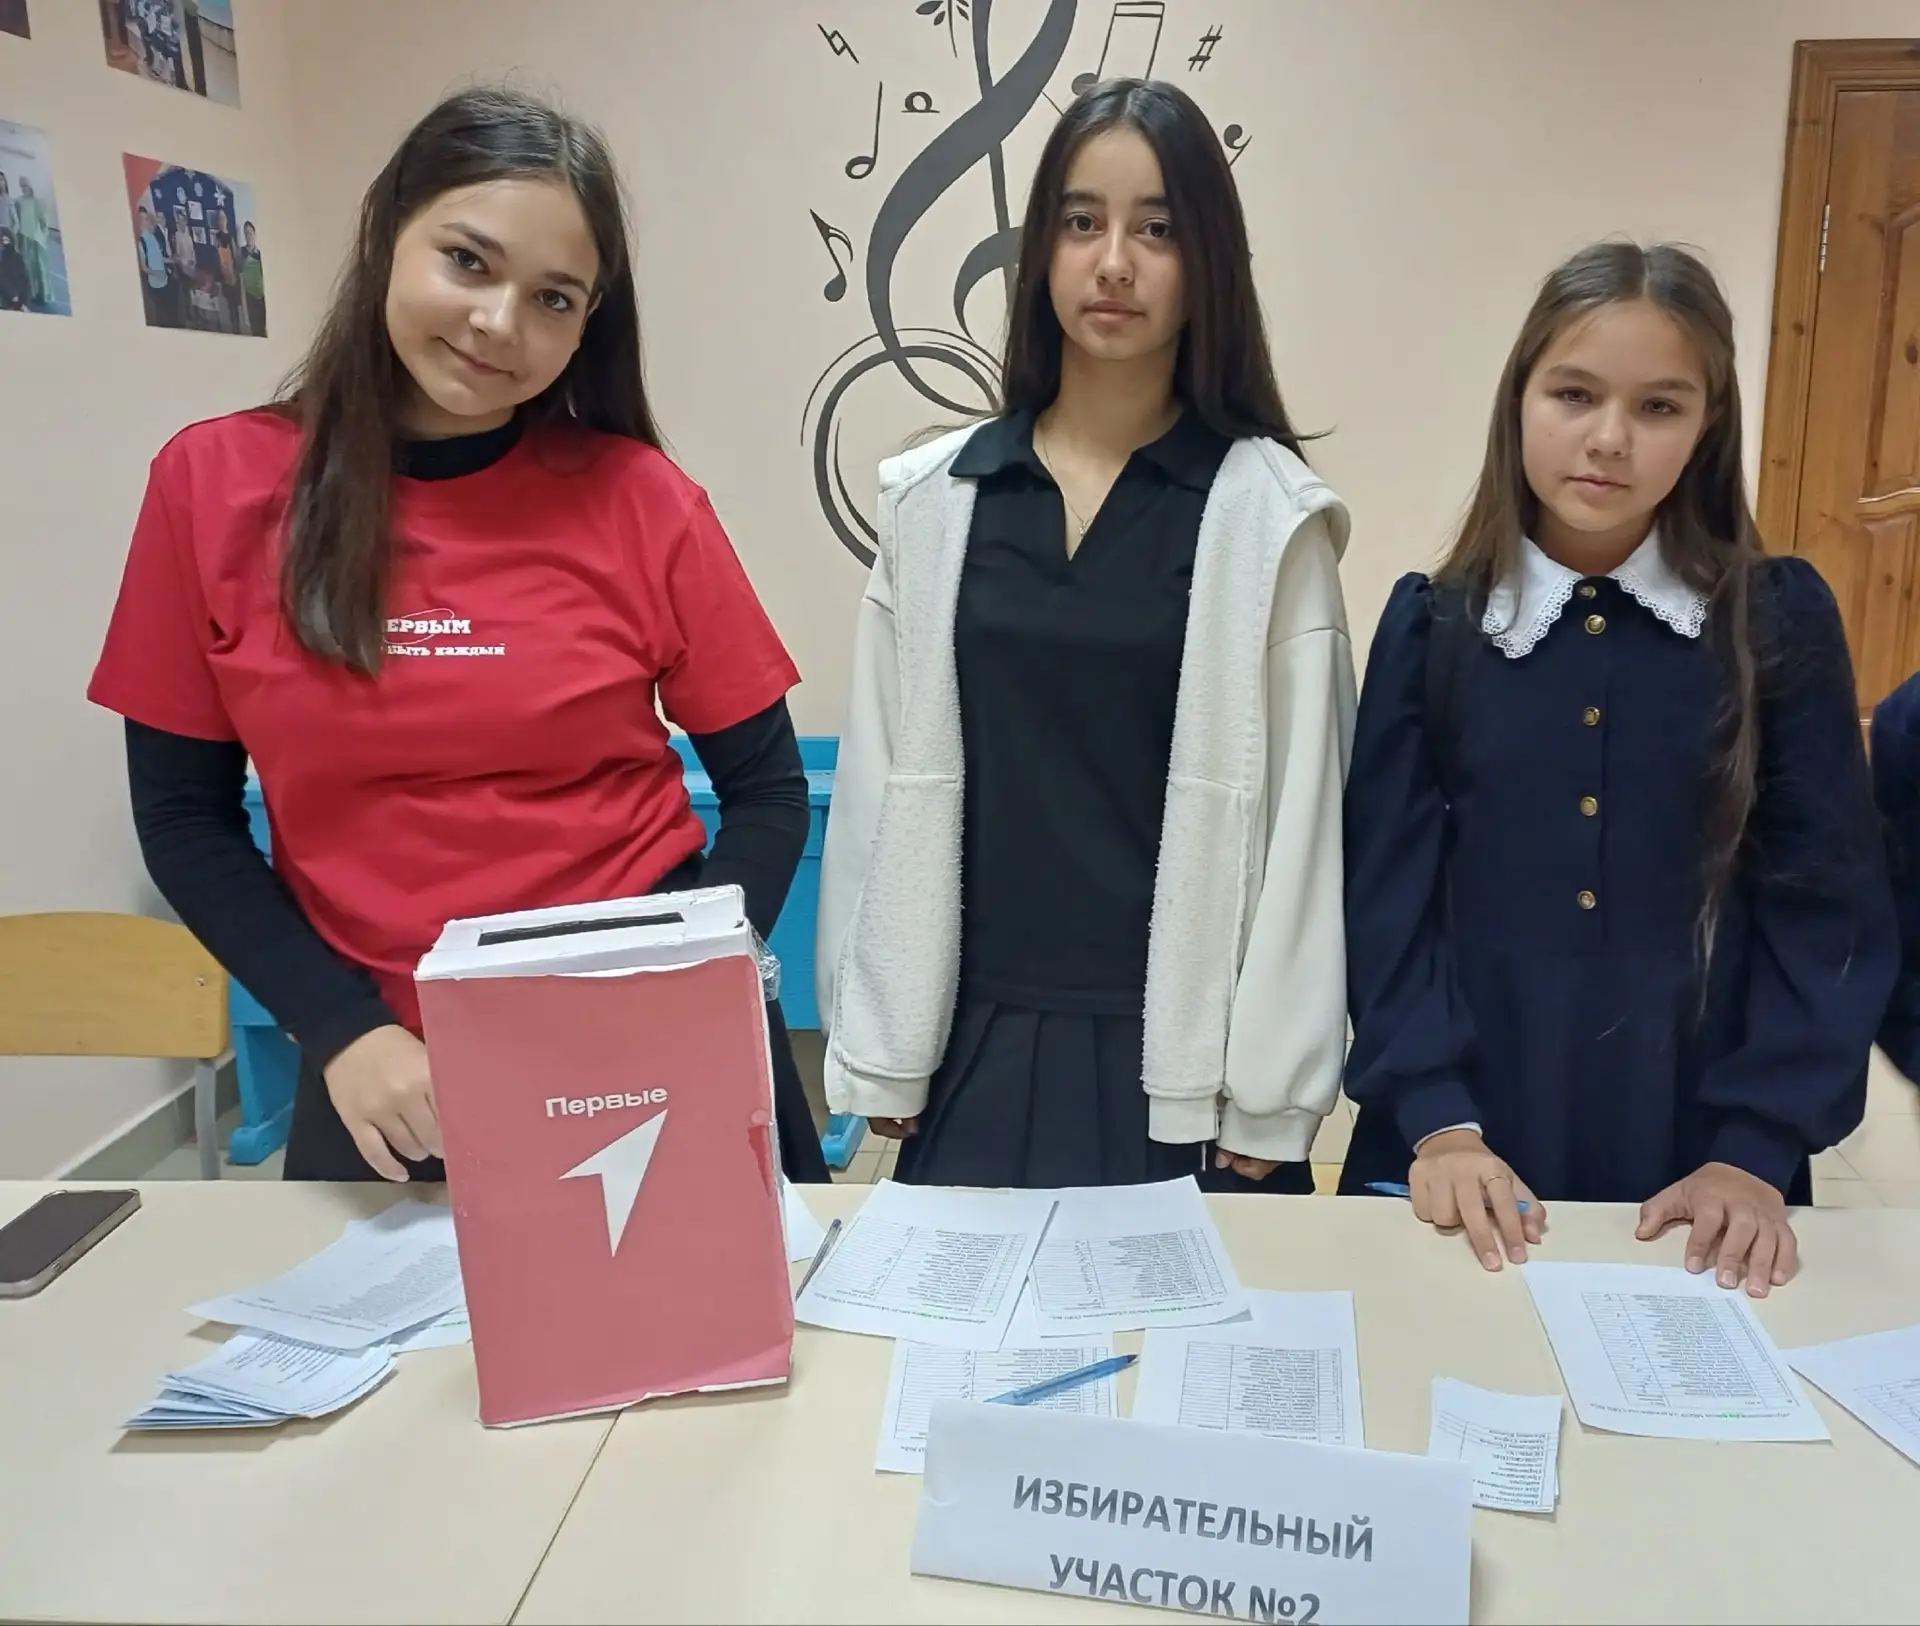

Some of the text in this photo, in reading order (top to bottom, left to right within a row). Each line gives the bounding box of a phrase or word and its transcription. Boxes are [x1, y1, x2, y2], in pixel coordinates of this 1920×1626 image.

[384, 618, 472, 635] ЕРВЫМ
[545, 1088, 668, 1118] Первые
[1013, 1475, 1374, 1563] ИЗБИРАТЕЛЬНЫЙ
[1049, 1553, 1320, 1626] УЧАСТОК №2
